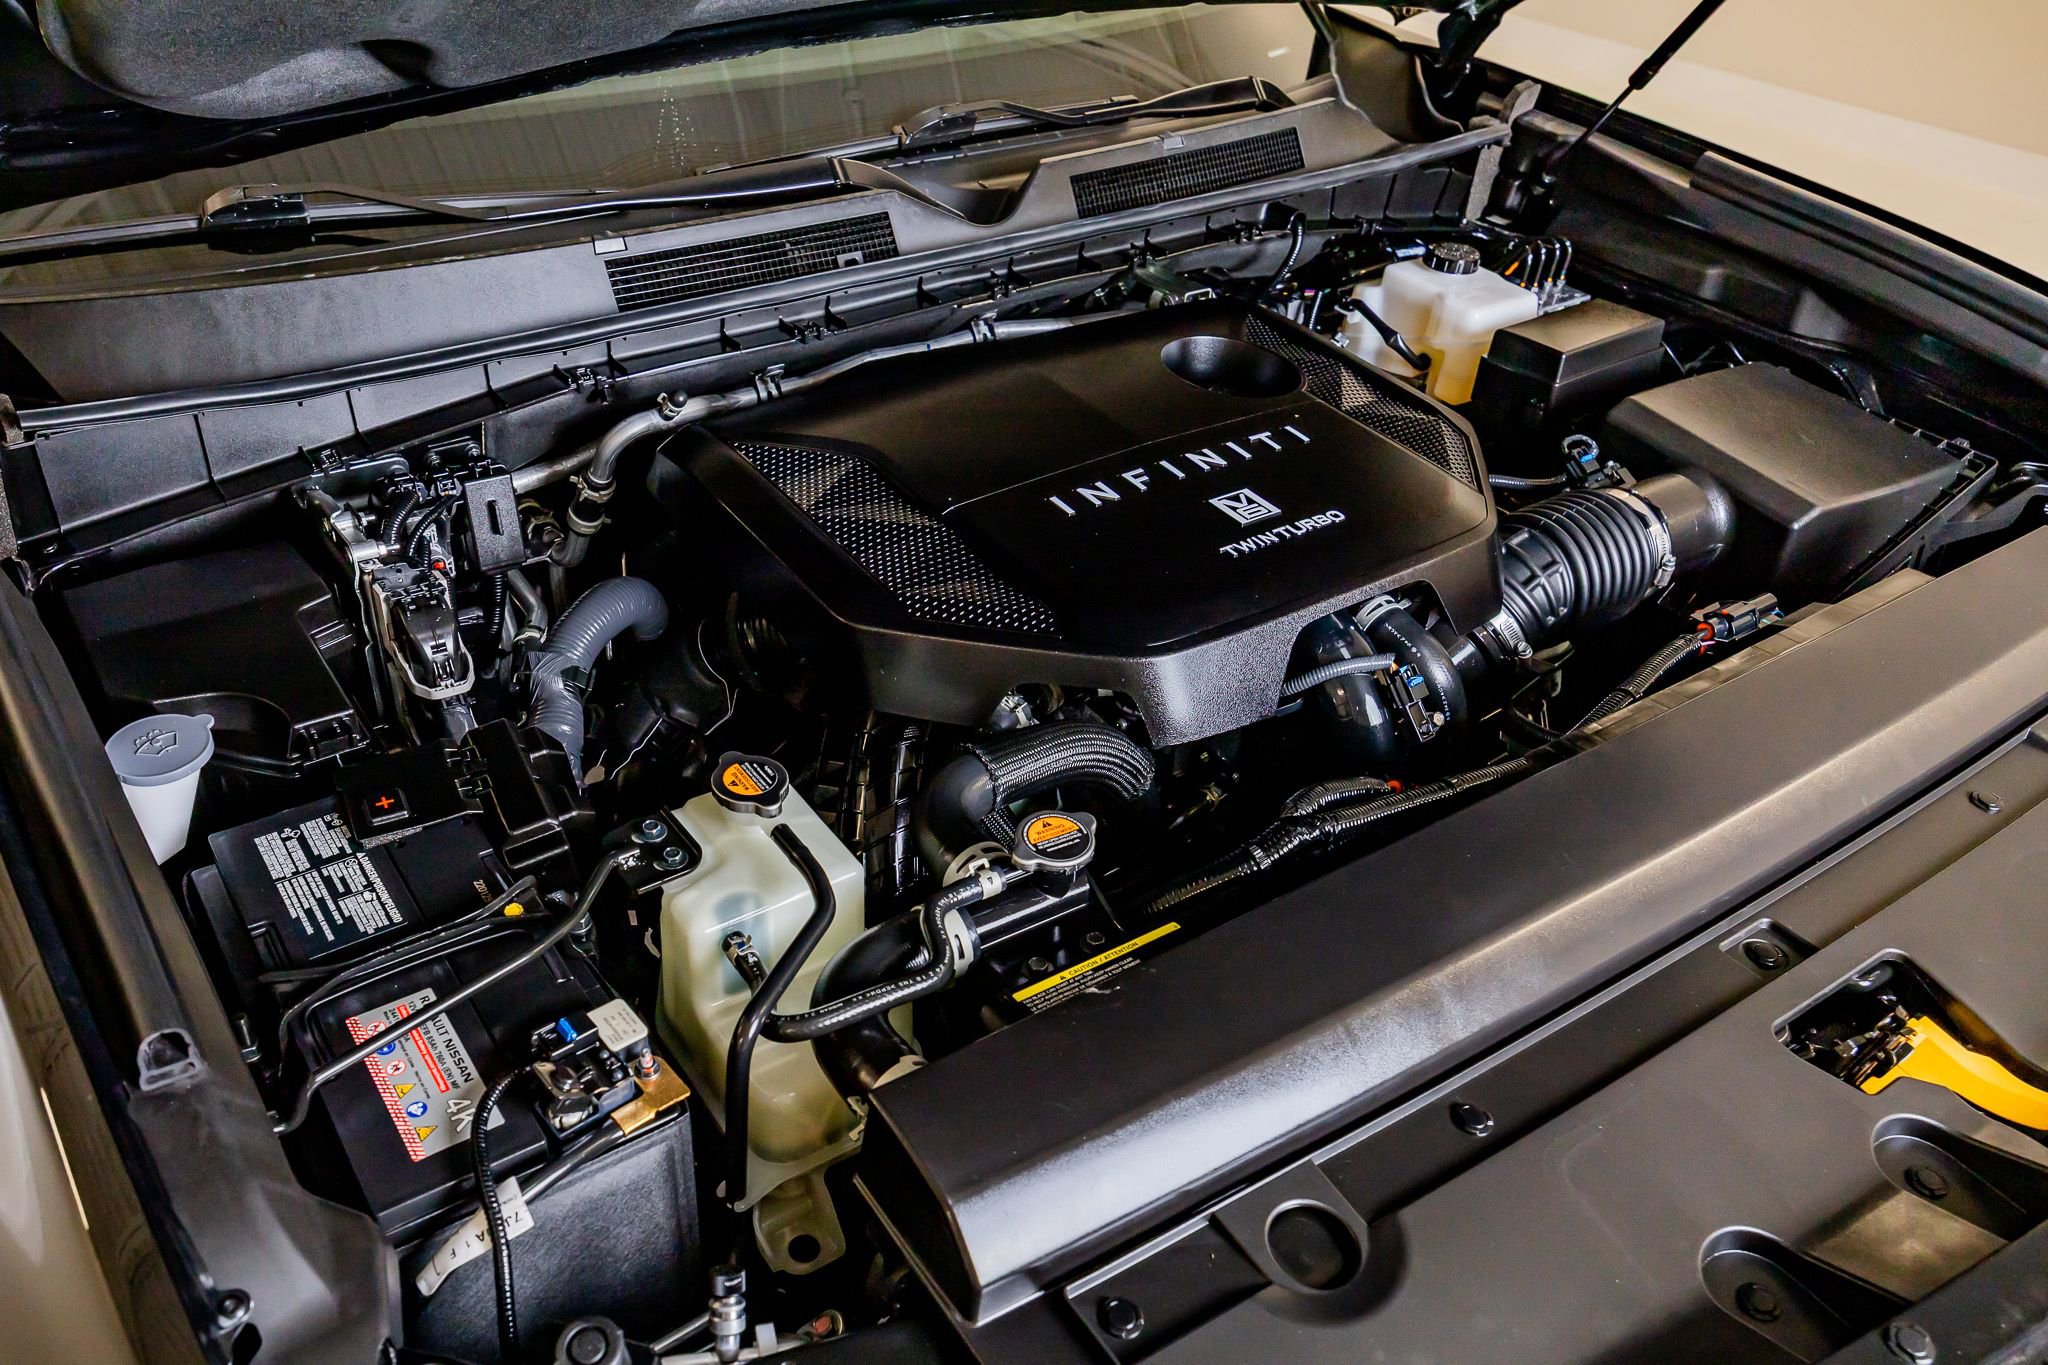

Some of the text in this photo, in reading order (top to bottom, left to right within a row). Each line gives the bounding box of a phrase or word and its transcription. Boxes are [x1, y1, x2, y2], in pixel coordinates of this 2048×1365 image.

[1049, 425, 1311, 517] INFINITI
[1036, 823, 1065, 836] WARNING
[1069, 960, 1098, 976] CAUTION
[1102, 942, 1138, 963] ATTENTION
[442, 1037, 473, 1083] NISSAN
[441, 1066, 454, 1081] (EN)
[450, 1080, 459, 1090] MF
[446, 1097, 477, 1133] 4K
